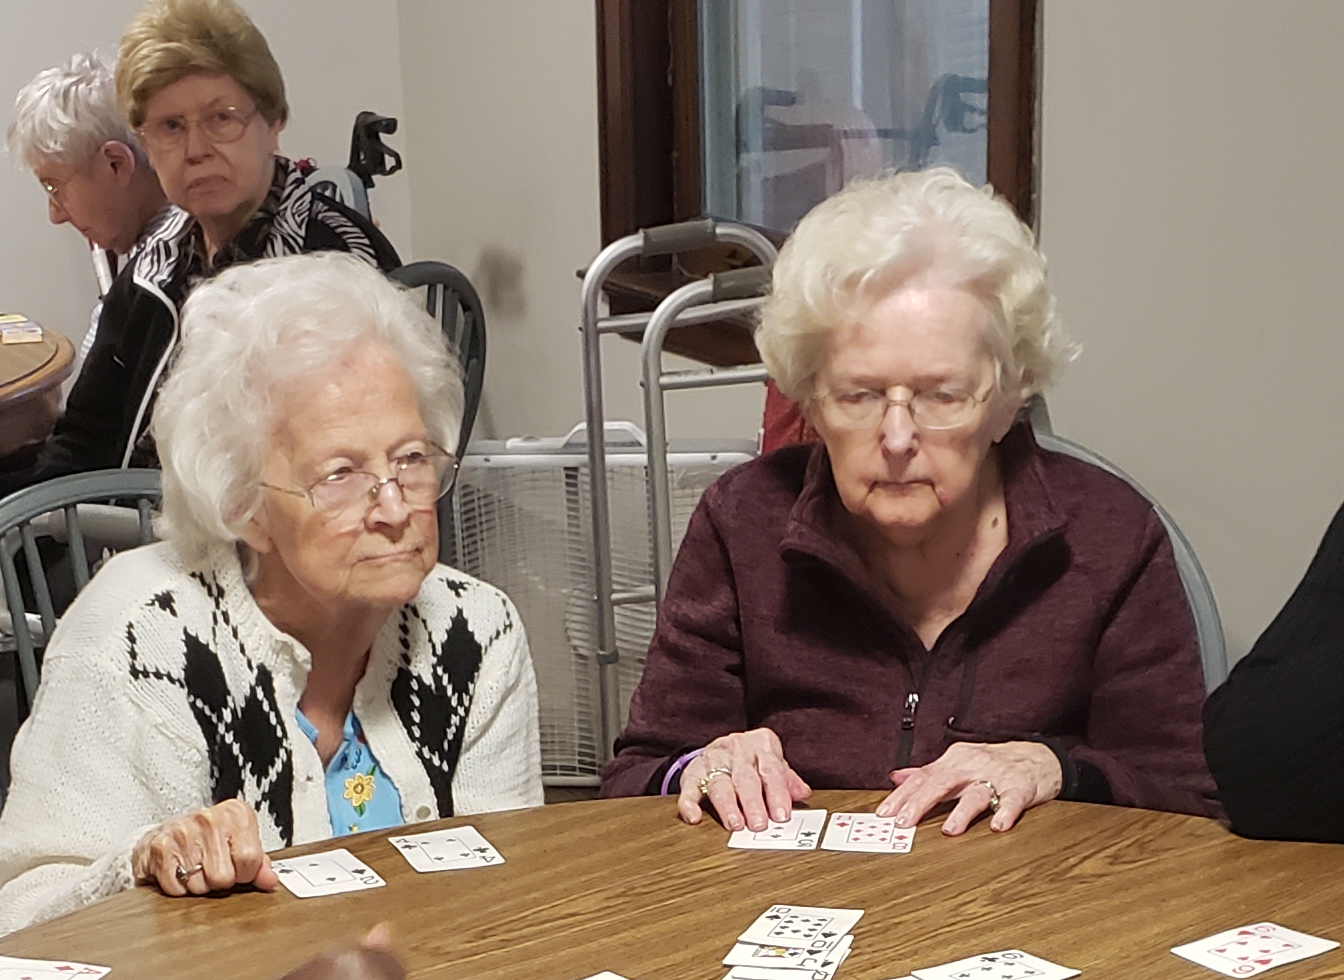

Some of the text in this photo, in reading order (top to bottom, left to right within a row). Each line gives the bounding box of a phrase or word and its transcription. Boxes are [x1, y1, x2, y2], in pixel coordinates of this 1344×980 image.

[480, 854, 497, 863] 4
[359, 875, 380, 885] 2
[770, 906, 791, 914] 10
[810, 940, 835, 949] 10
[796, 958, 818, 967] J
[811, 969, 832, 980] Q
